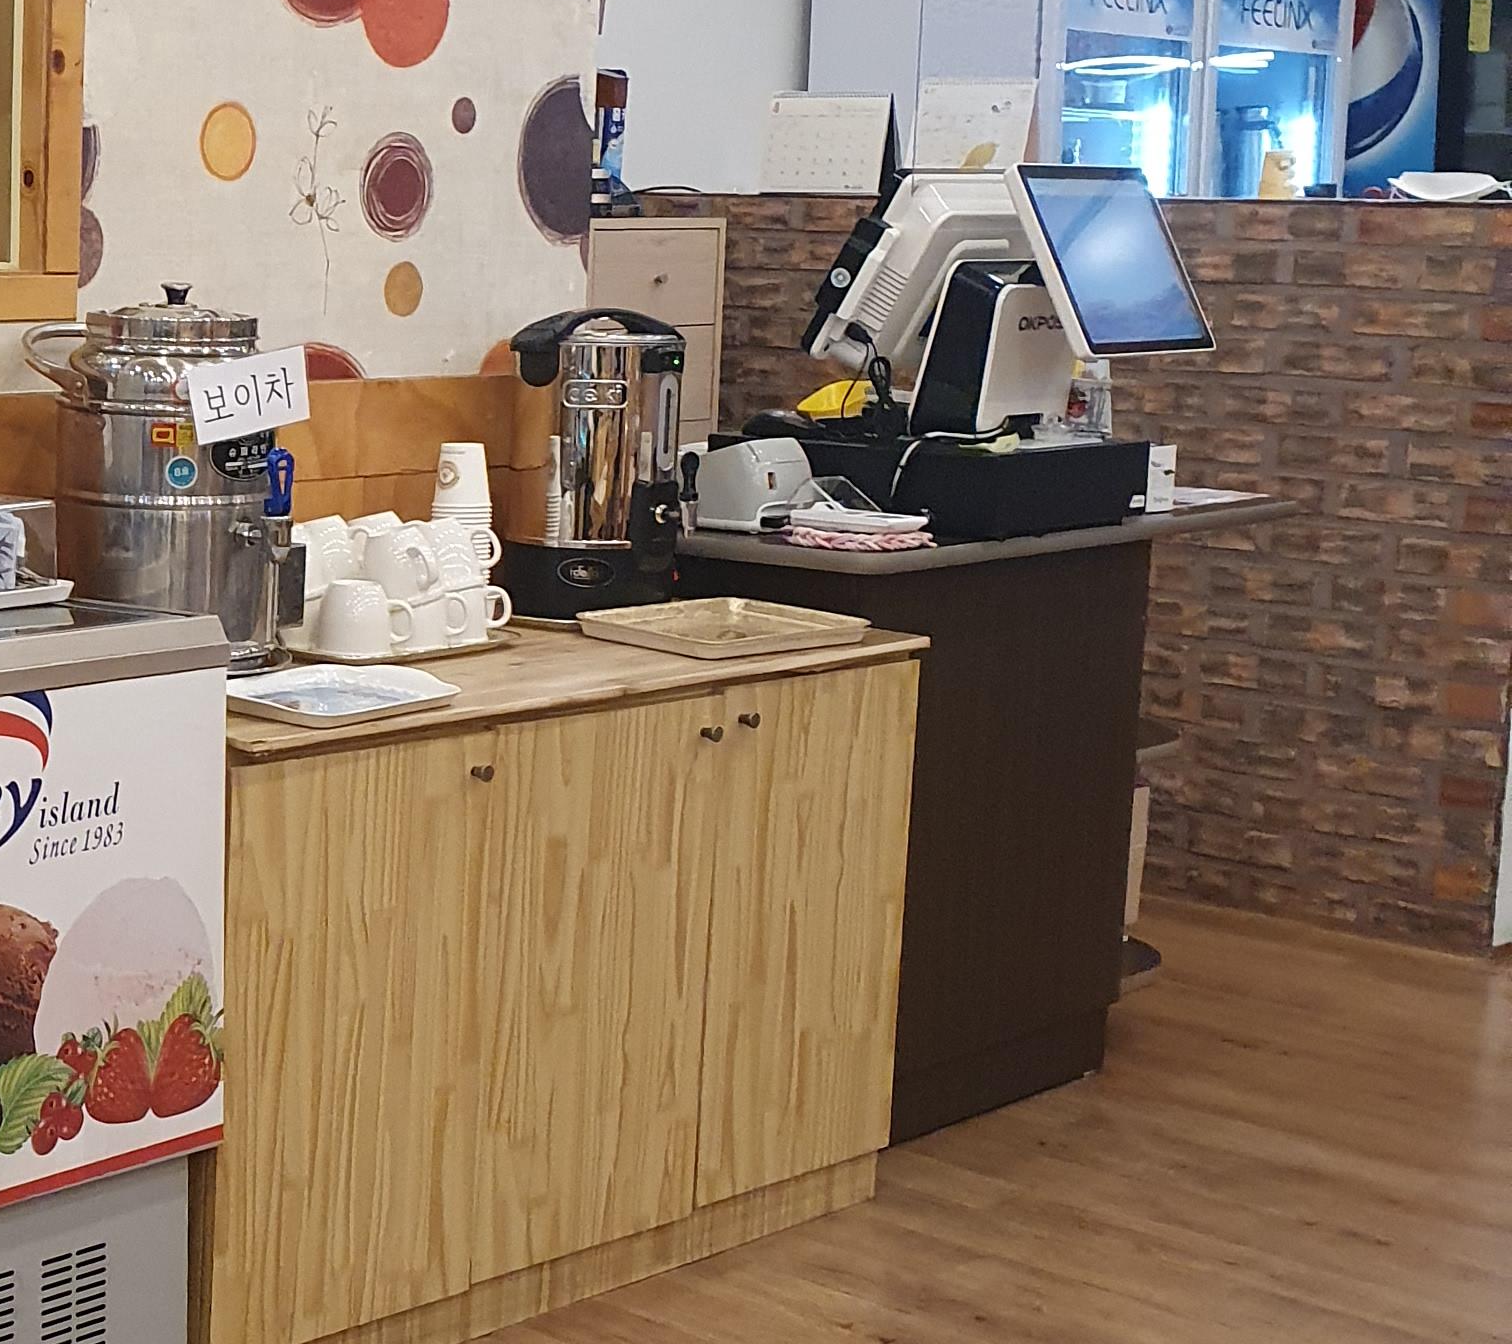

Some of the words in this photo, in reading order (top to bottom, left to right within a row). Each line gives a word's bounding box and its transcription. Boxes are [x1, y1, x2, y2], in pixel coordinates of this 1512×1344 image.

[203, 367, 294, 423] 보이차
[39, 781, 120, 829] island
[29, 837, 78, 865] Since
[81, 821, 125, 853] 1983
